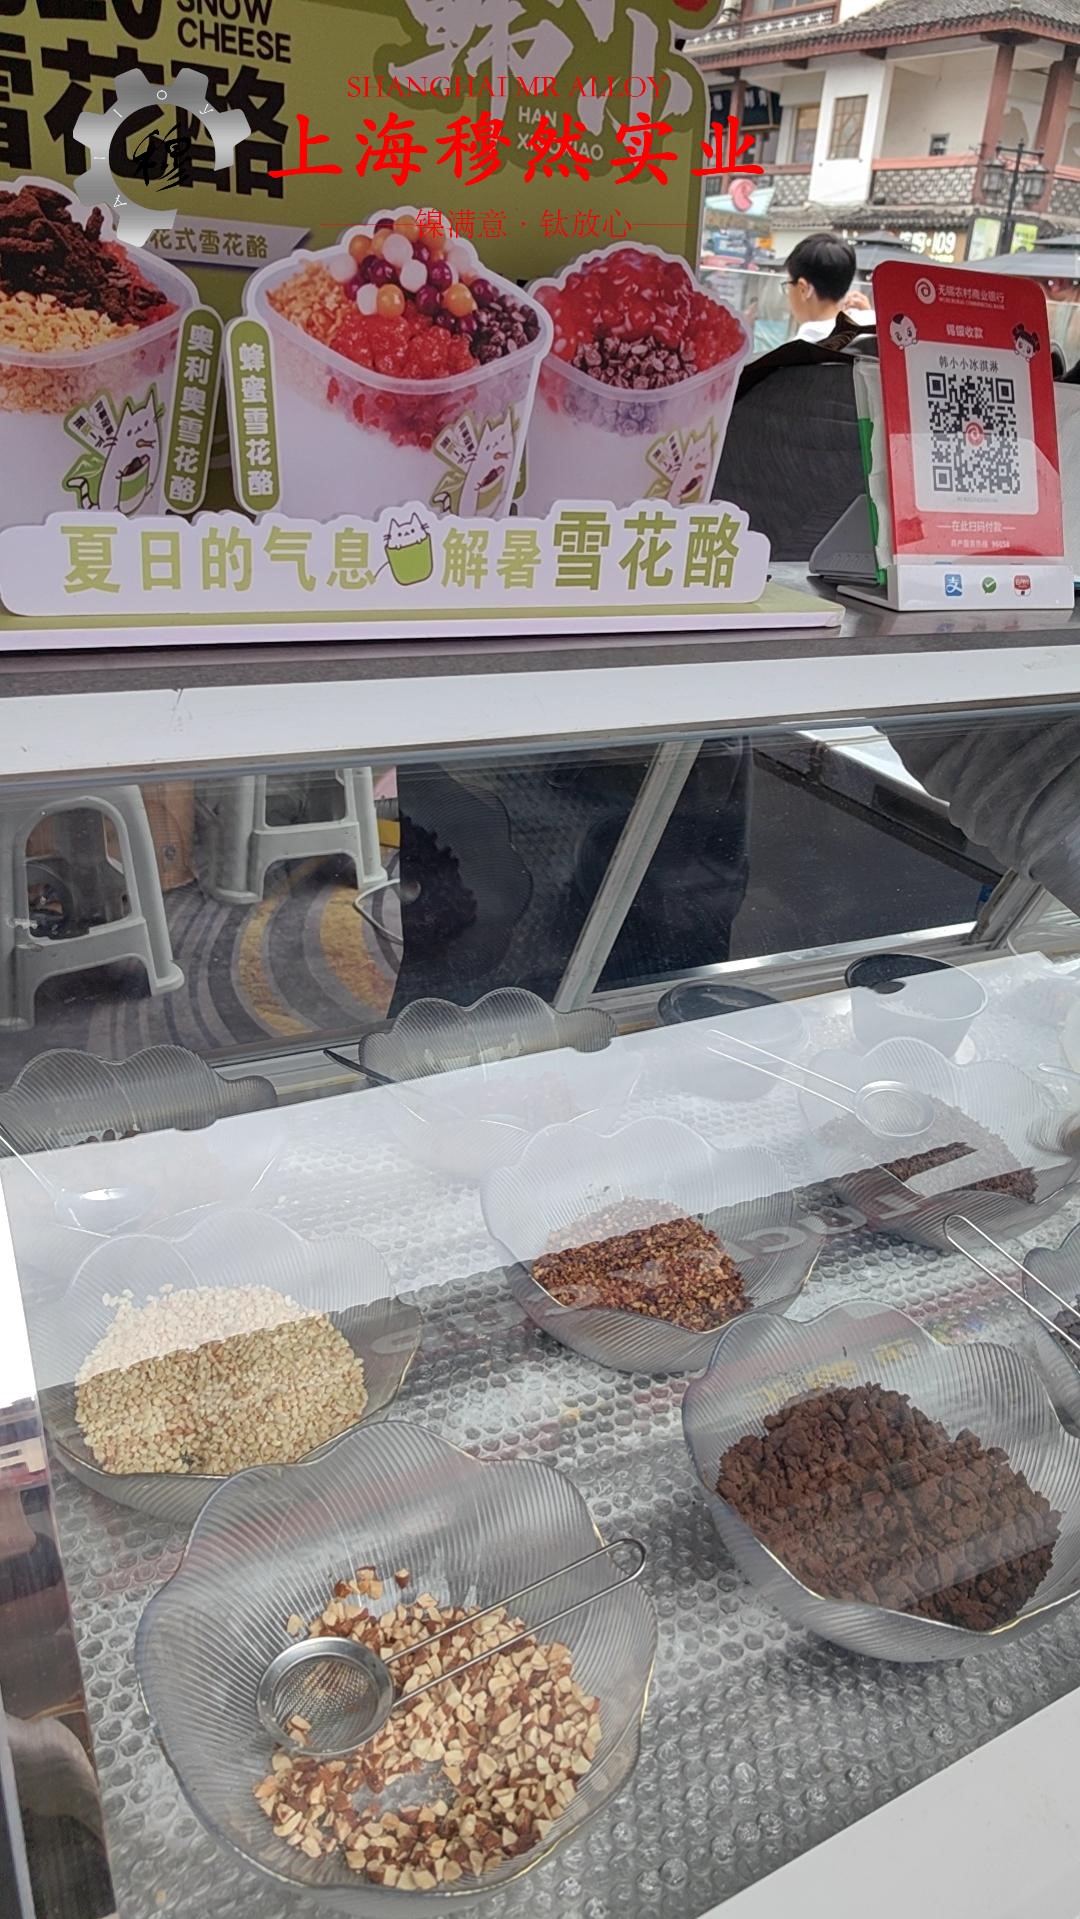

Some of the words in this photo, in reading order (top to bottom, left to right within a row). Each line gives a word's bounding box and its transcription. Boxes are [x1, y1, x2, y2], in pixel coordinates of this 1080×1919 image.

[177, 17, 292, 64] CHEESE
[0, 32, 289, 200] 花酪
[518, 105, 557, 128] HAN
[150, 227, 268, 259] 花式雪花酪
[938, 354, 1000, 373] 韩小小冰淇淋
[168, 323, 215, 504] 奥利奥雪花酪
[237, 342, 275, 497] 蜂蜜雪花酪
[60, 525, 378, 593] 夏日的气息
